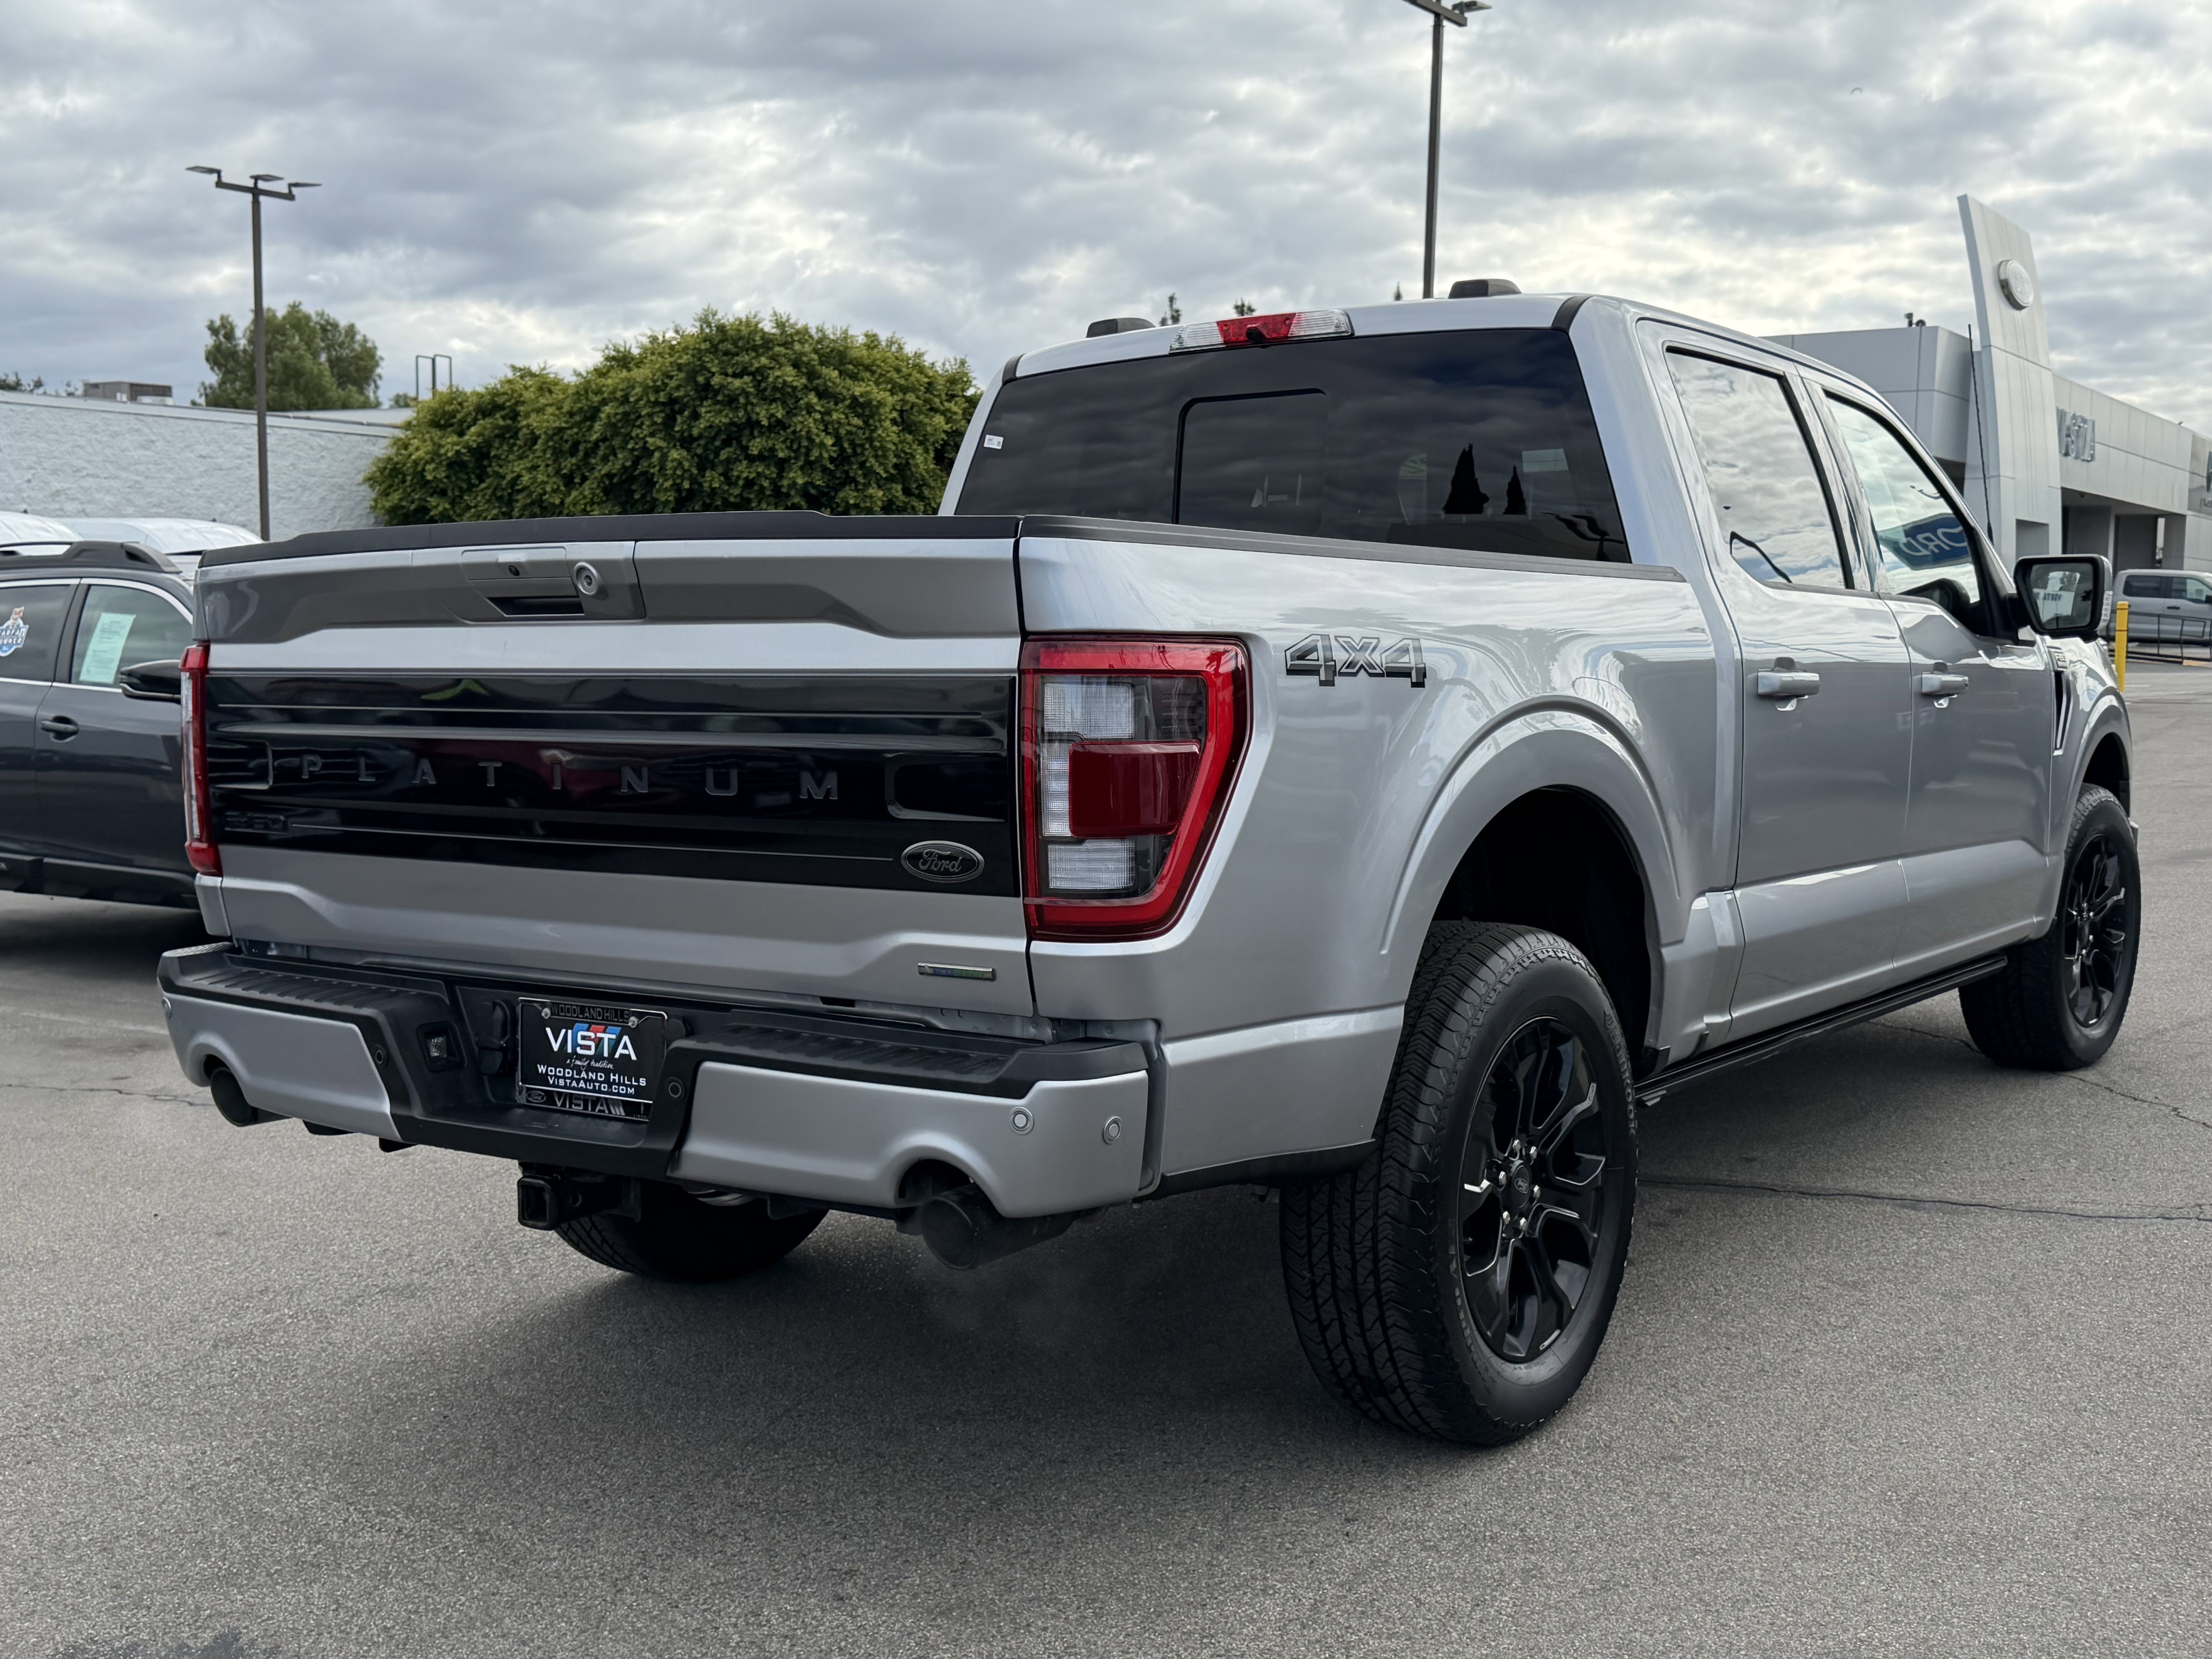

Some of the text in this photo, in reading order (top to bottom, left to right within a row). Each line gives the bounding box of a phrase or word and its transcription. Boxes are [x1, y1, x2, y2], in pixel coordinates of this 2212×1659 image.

[300, 753, 839, 800] PLATINUM
[919, 849, 963, 872] Ford
[551, 1003, 629, 1022] WOODLAND HILLS
[545, 1027, 637, 1061] VISTA
[537, 1064, 646, 1086] WOODLAND HILLS
[553, 1090, 609, 1114] VISTA
